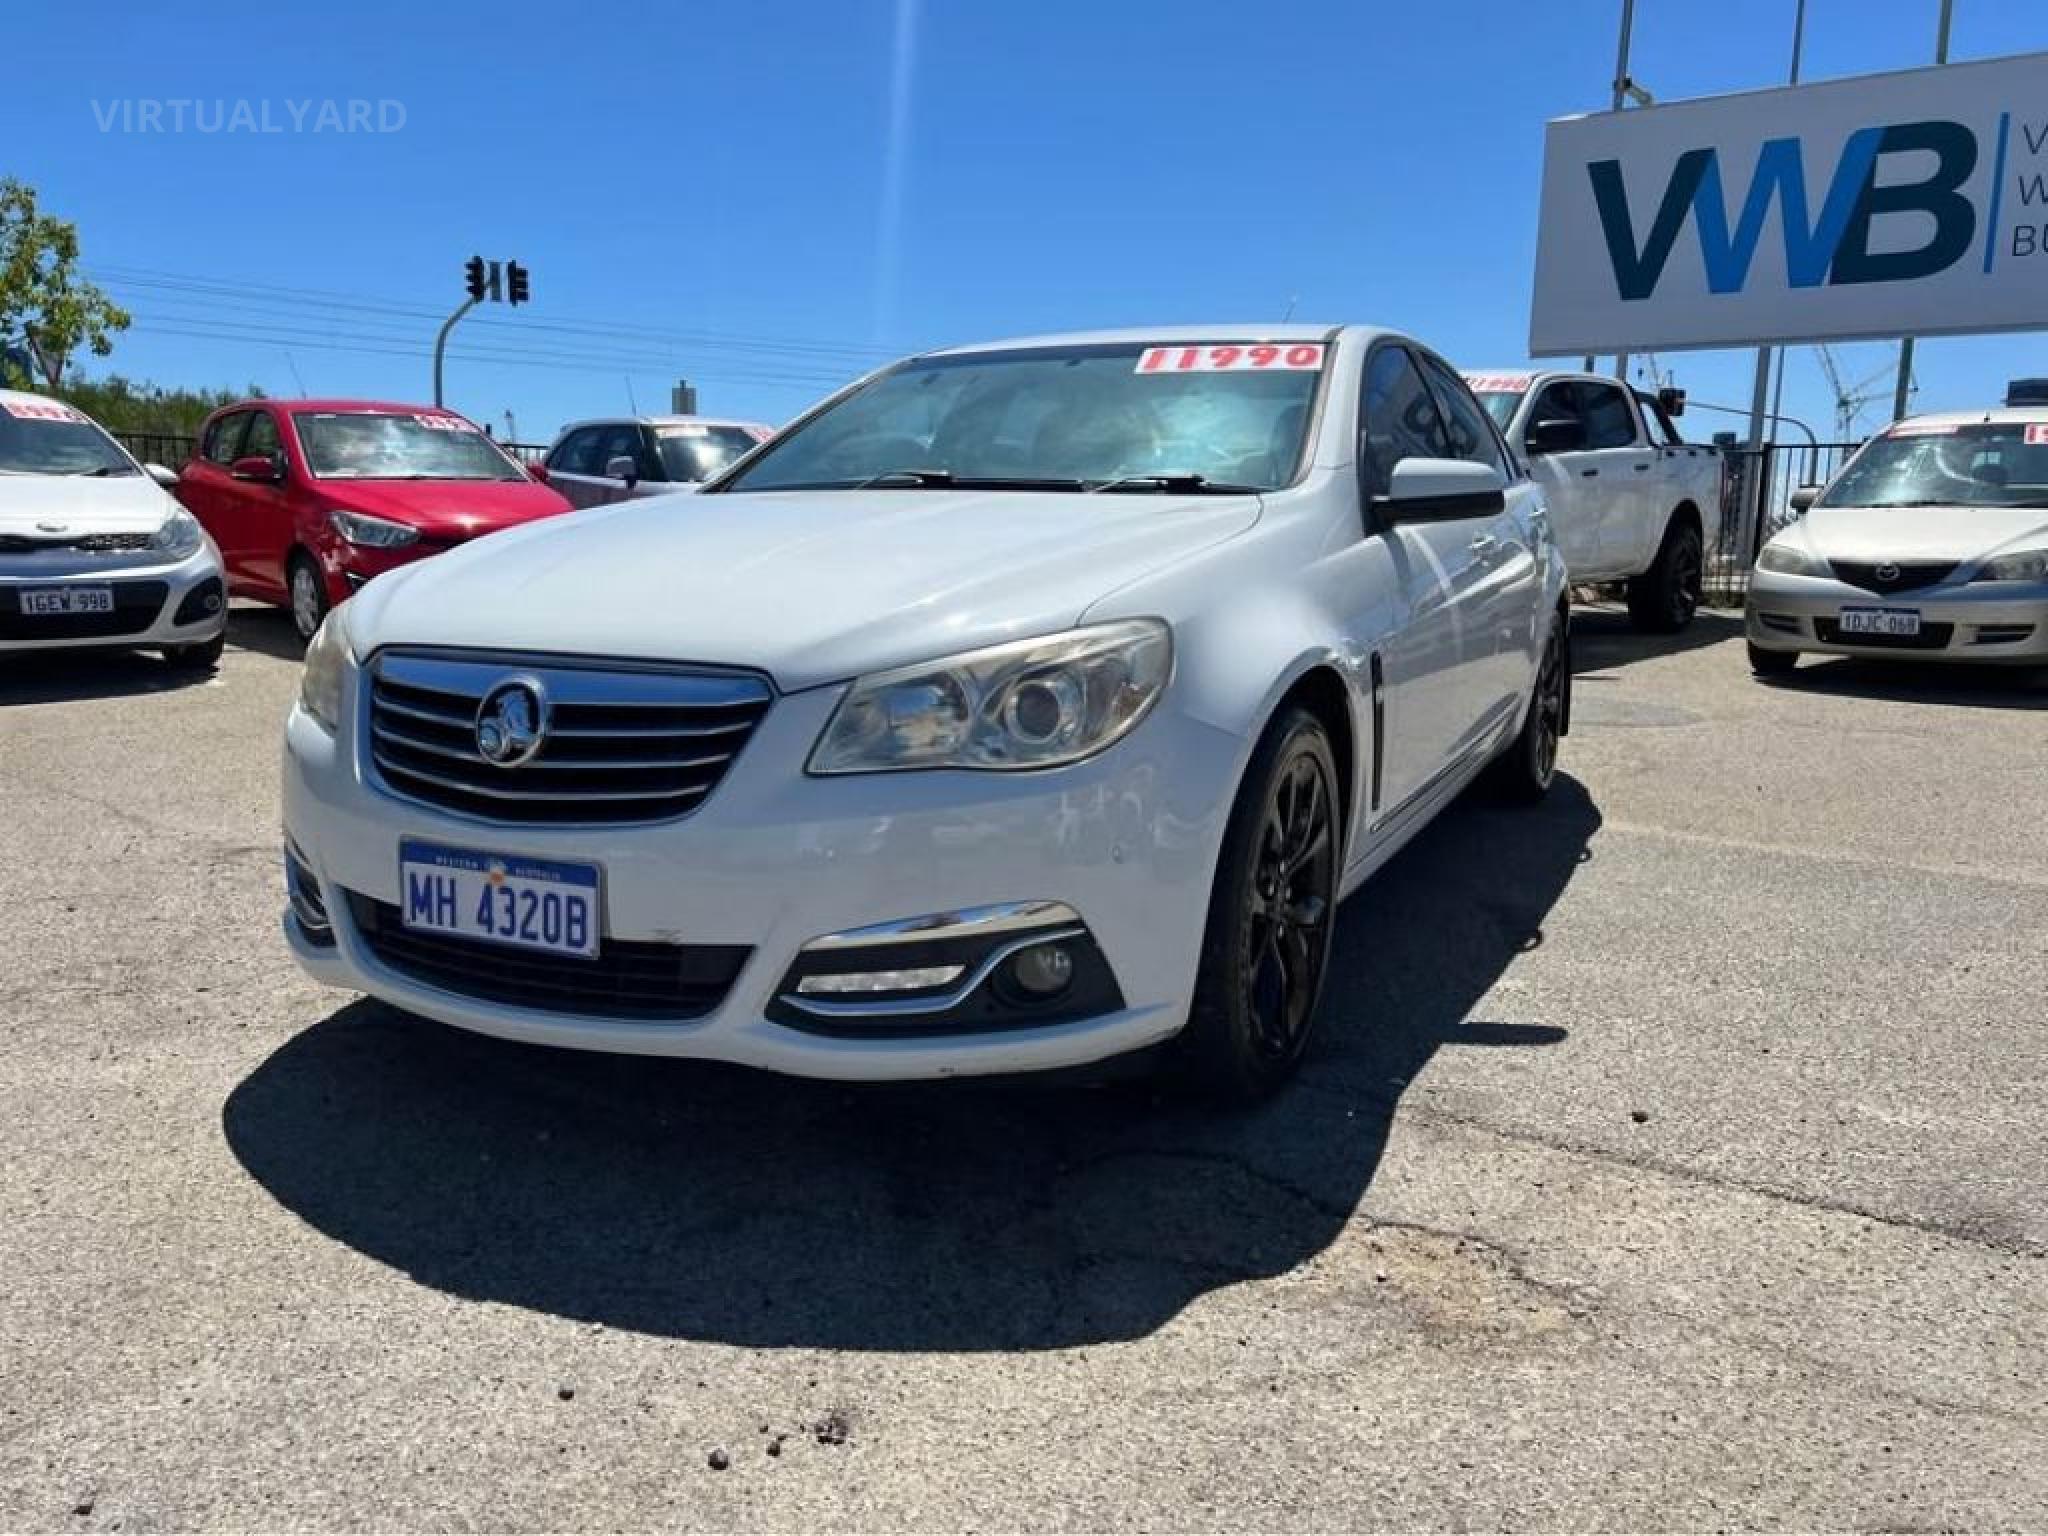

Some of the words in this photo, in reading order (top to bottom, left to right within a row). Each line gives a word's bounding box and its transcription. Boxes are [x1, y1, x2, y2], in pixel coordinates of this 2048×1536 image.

[1586, 121, 1979, 301] VWB
[2011, 223, 2048, 257] B
[1142, 345, 1323, 371] 11990
[409, 871, 456, 929] MH
